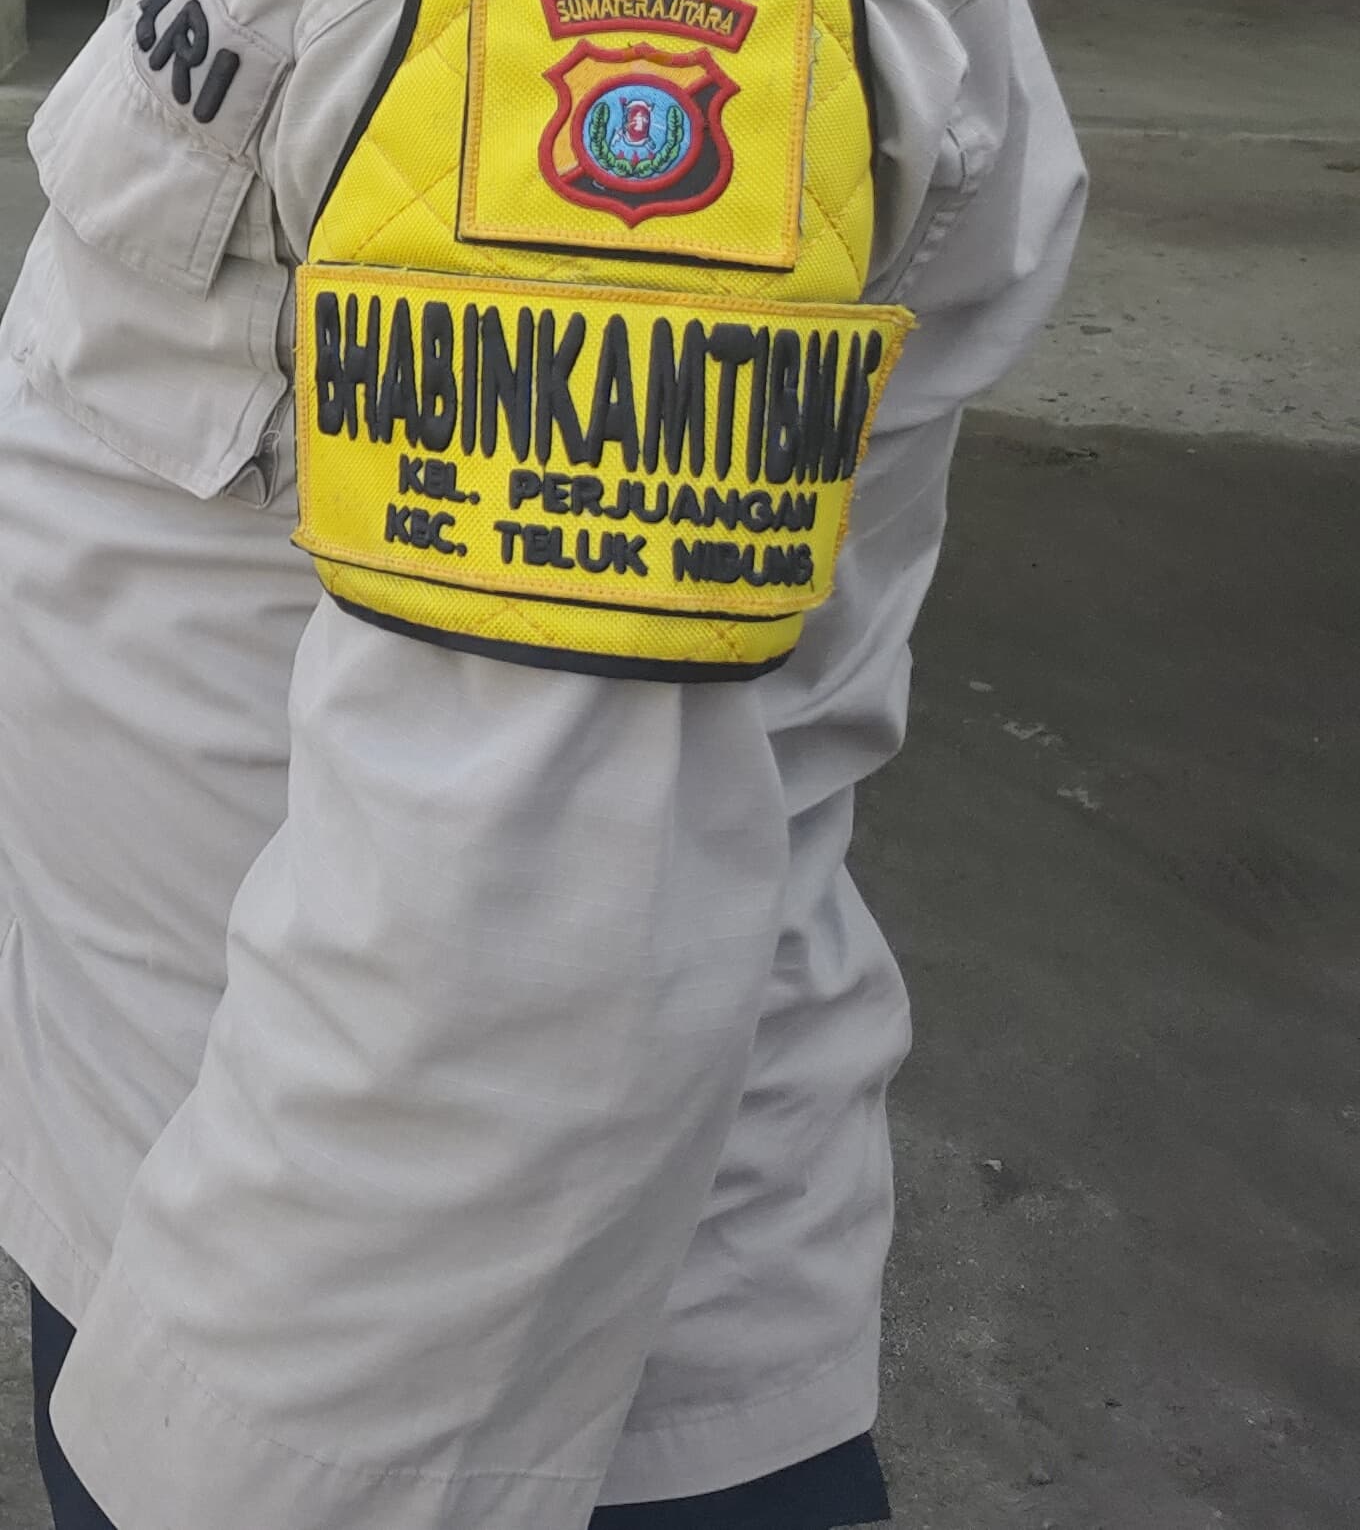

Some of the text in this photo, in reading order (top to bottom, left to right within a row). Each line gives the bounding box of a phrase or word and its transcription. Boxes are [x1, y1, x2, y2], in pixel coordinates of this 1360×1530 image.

[399, 453, 818, 534] KEL. PERJUANGAN
[385, 503, 467, 557] KEC.
[494, 520, 648, 577] TELUK
